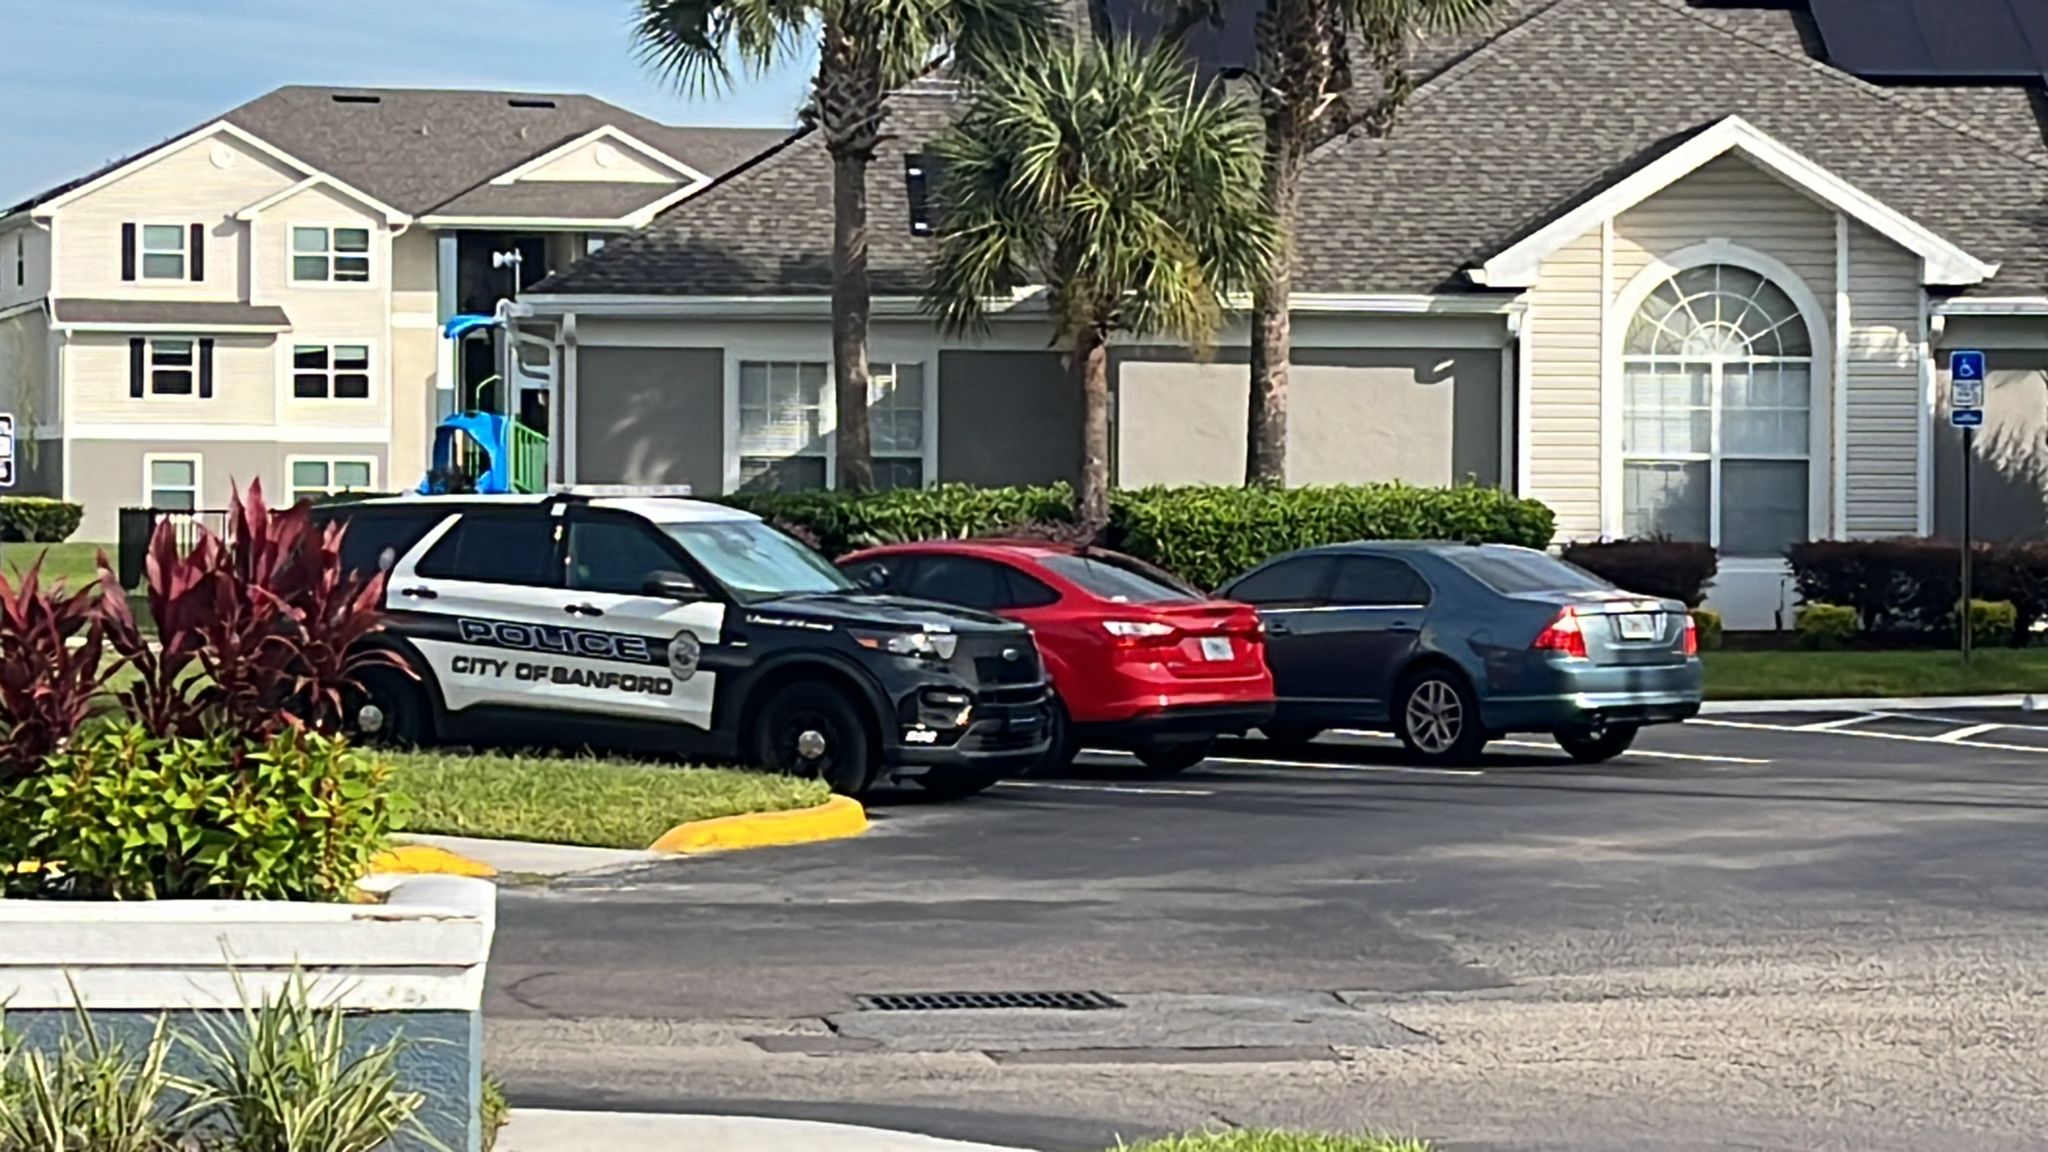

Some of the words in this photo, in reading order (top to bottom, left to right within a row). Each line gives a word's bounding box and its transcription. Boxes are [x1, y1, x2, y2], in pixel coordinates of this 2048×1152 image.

[457, 618, 651, 661] POLICE
[451, 655, 508, 677] CITY
[515, 662, 549, 681] OF
[551, 666, 673, 695] SANFORD
